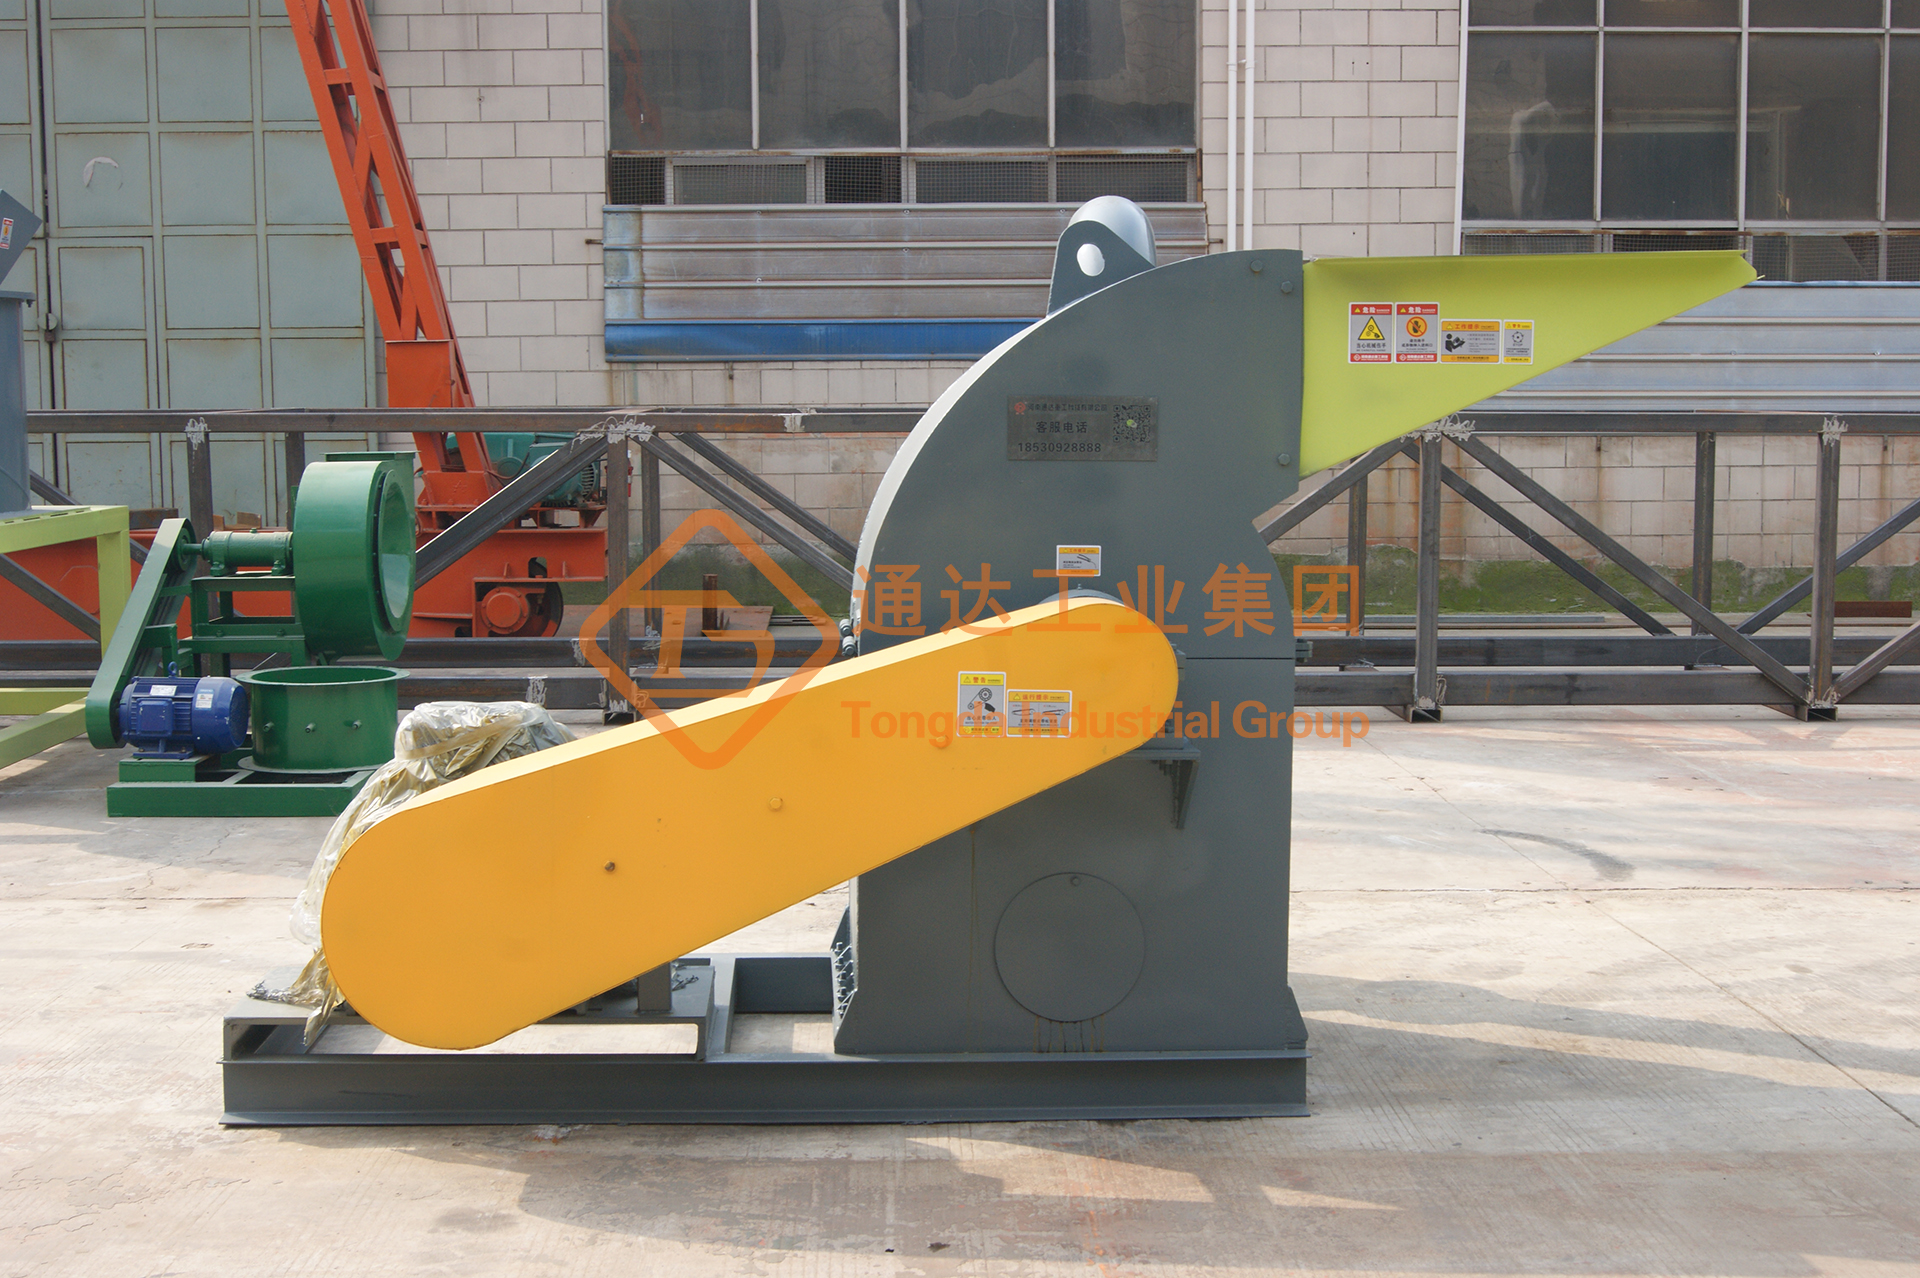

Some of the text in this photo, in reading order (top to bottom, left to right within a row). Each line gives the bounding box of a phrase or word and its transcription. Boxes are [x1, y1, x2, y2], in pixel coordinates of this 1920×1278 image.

[1036, 421, 1088, 434] 客服电话
[1018, 442, 1102, 452] 18530928888
